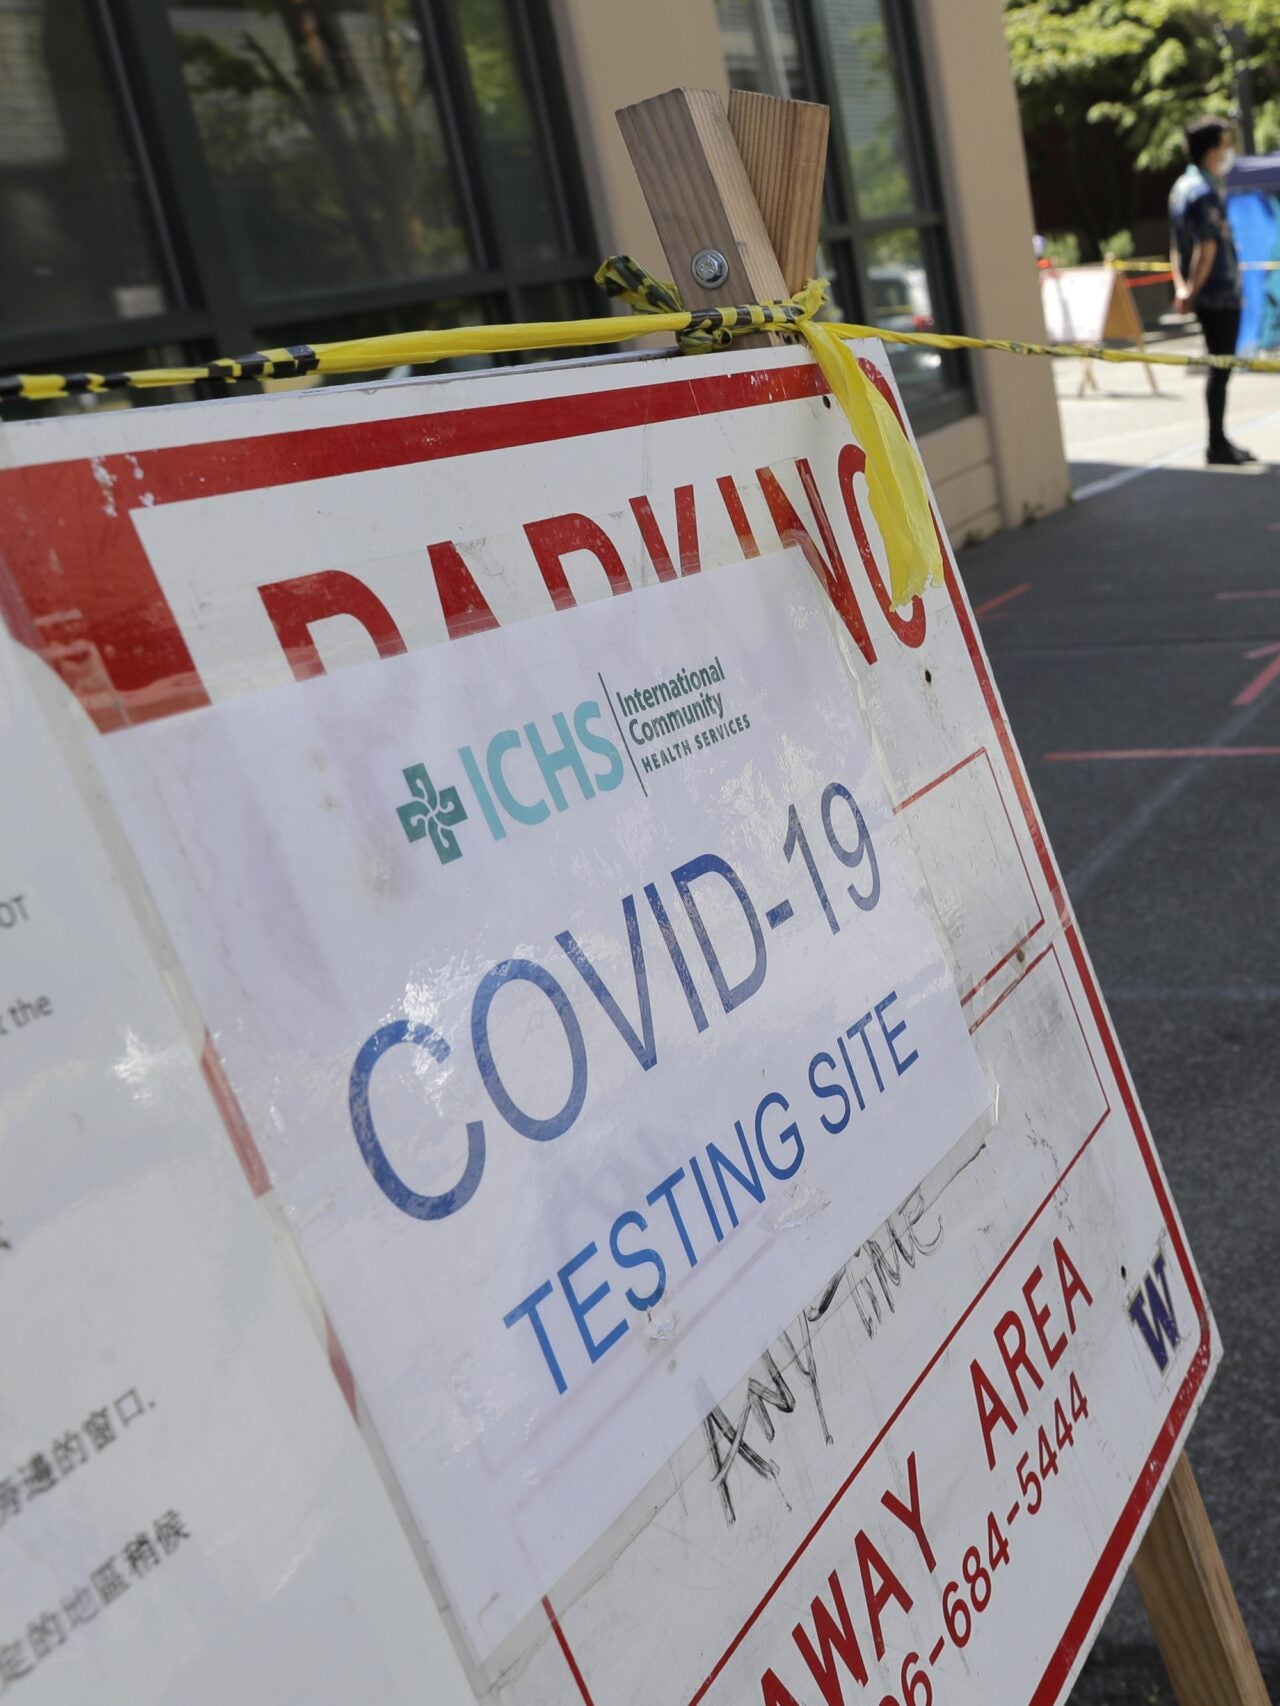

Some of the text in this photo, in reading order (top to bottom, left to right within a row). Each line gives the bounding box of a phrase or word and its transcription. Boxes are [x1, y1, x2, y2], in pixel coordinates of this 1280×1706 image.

[616, 656, 725, 717] International
[629, 692, 724, 745] Community
[641, 714, 751, 773] HEALTH SERVICES
[457, 700, 624, 842] ICHS
[349, 782, 881, 1221] COVID-19
[503, 991, 919, 1395] TESTING SITE
[969, 1236, 1093, 1470] AREA
[1128, 1253, 1180, 1374] W
